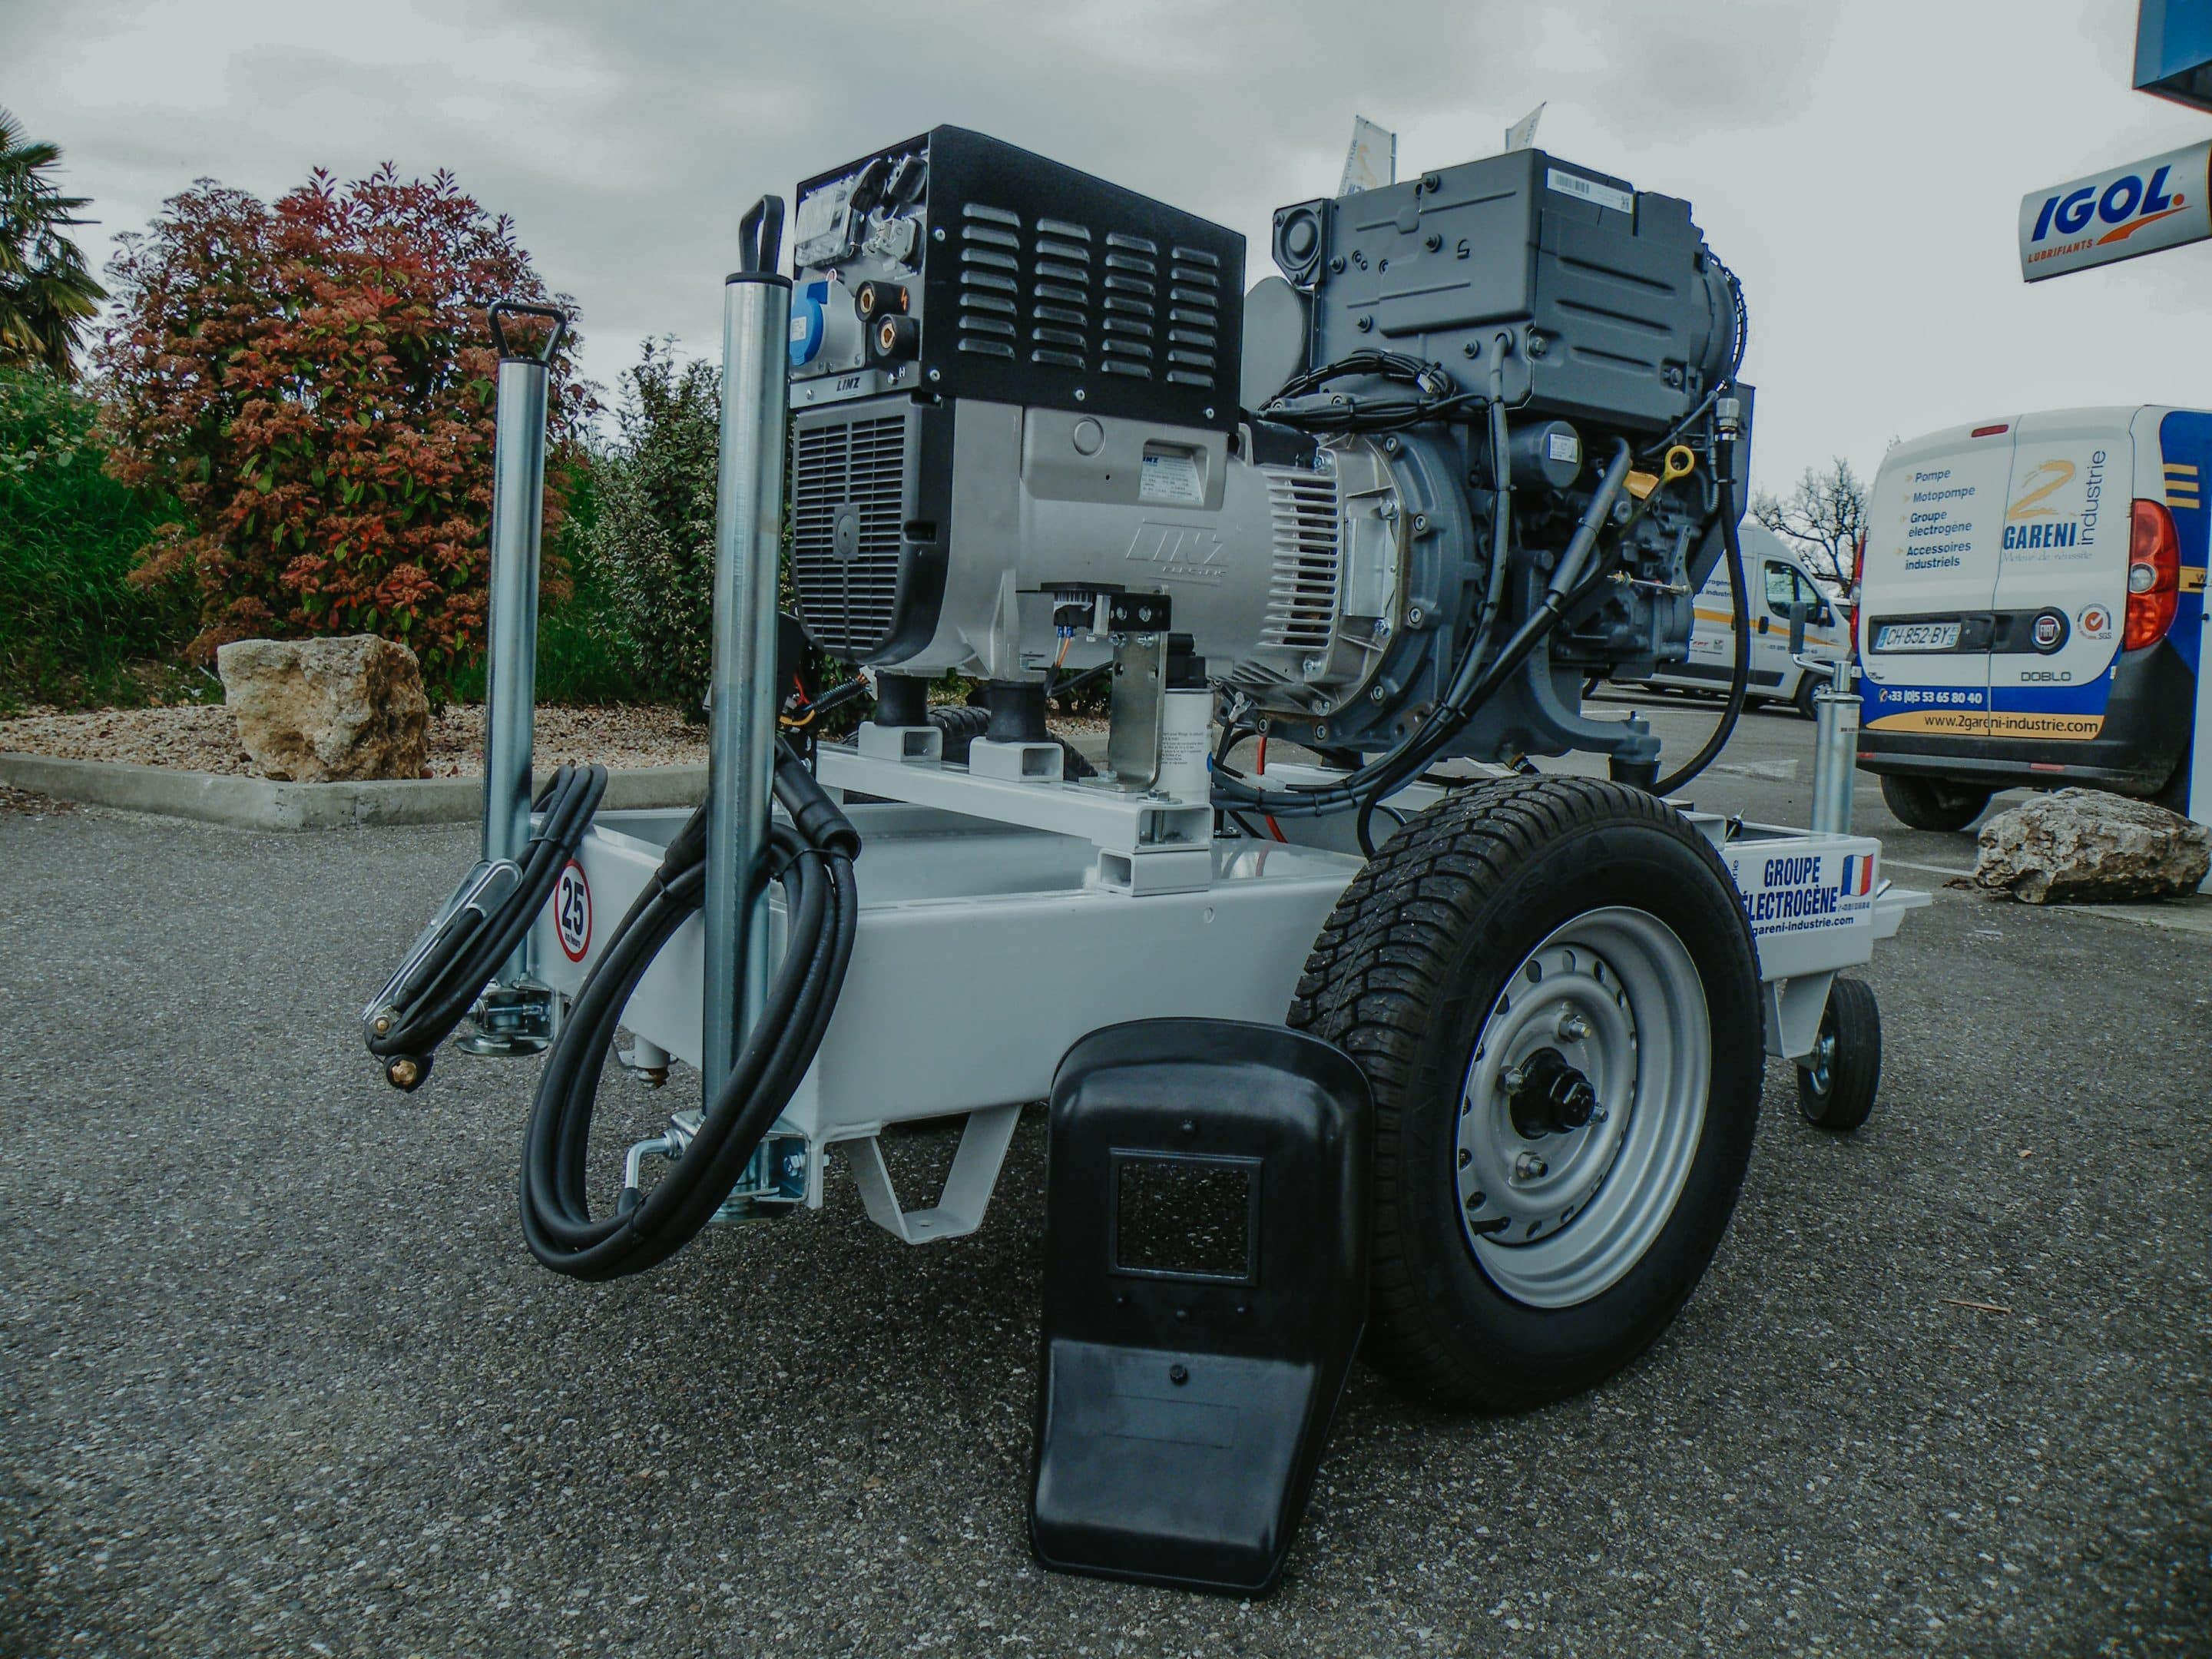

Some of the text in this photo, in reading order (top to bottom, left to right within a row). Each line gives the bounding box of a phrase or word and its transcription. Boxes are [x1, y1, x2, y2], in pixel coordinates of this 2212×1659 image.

[2028, 239, 2093, 263] LUBRIFIANTS
[836, 377, 860, 392] LINZ
[1915, 469, 1951, 483] Pompe
[1913, 486, 1976, 503] Motopompe
[2077, 450, 2106, 546] industrie
[1910, 511, 1948, 523] Groupe
[2002, 522, 2077, 550] GARENI
[1906, 541, 1972, 556] Accessoires
[1905, 556, 1961, 571] industriels
[2021, 671, 2071, 681] DOBLO
[1922, 691, 1935, 704] 53
[1936, 691, 1949, 704] 65
[1951, 692, 1965, 704] 80
[1967, 692, 1983, 704] 40
[1924, 714, 2099, 733] www.2gareni-industrie.com
[1763, 856, 1822, 888] GROUPE
[562, 877, 584, 935] 25
